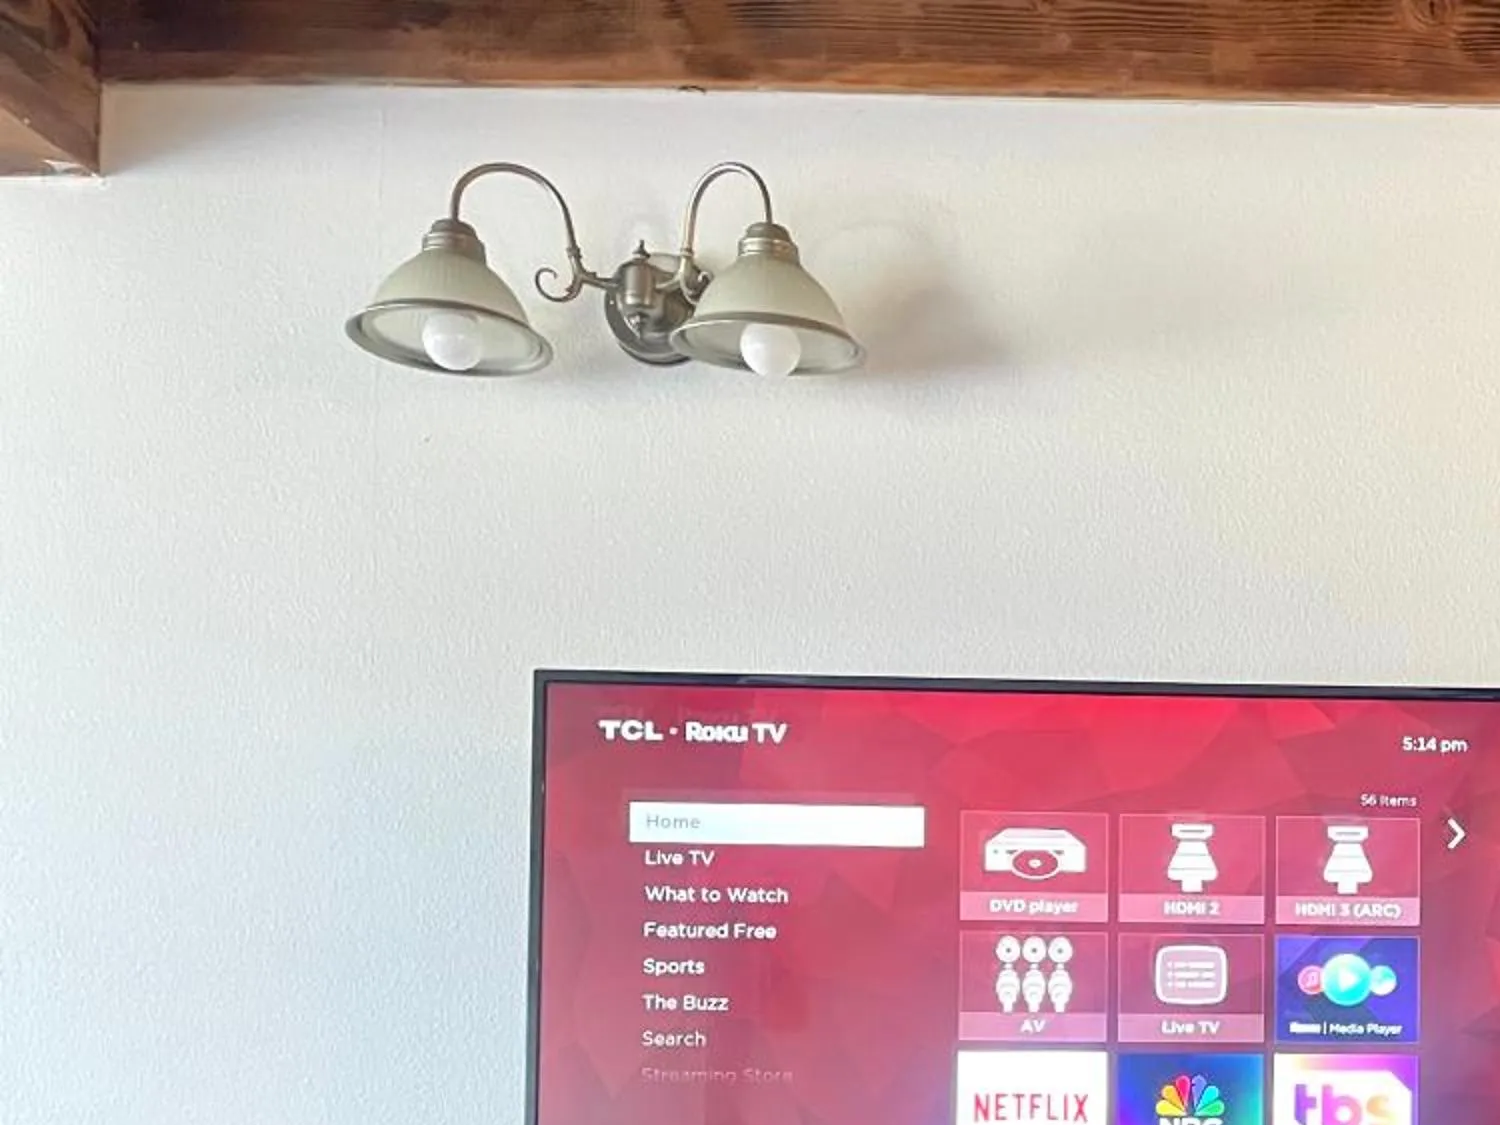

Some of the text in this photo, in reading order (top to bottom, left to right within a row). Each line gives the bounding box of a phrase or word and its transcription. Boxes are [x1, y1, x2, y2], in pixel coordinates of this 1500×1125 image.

[598, 720, 788, 744] TCL Roku TV
[1401, 736, 1469, 755] 5:14 pm
[1360, 793, 1377, 807] 56
[646, 813, 701, 830] Home
[644, 850, 715, 867] Live TV
[644, 886, 790, 905] What to Watch
[989, 899, 1079, 916] DVD player
[1163, 900, 1220, 915] HDMI 2
[1295, 902, 1402, 920] HDMI 3 (ARC)
[643, 921, 777, 939] Featured Free
[643, 957, 705, 977] Sports
[642, 993, 730, 1011] The Buzz
[1020, 1019, 1046, 1033] AV
[1161, 1020, 1220, 1034] Live TV
[1329, 1022, 1364, 1035] Media
[1366, 1022, 1403, 1037] Player
[641, 1030, 707, 1047] Search
[641, 1067, 794, 1084] Streaming Store
[973, 1093, 1089, 1122] NETFLIX
